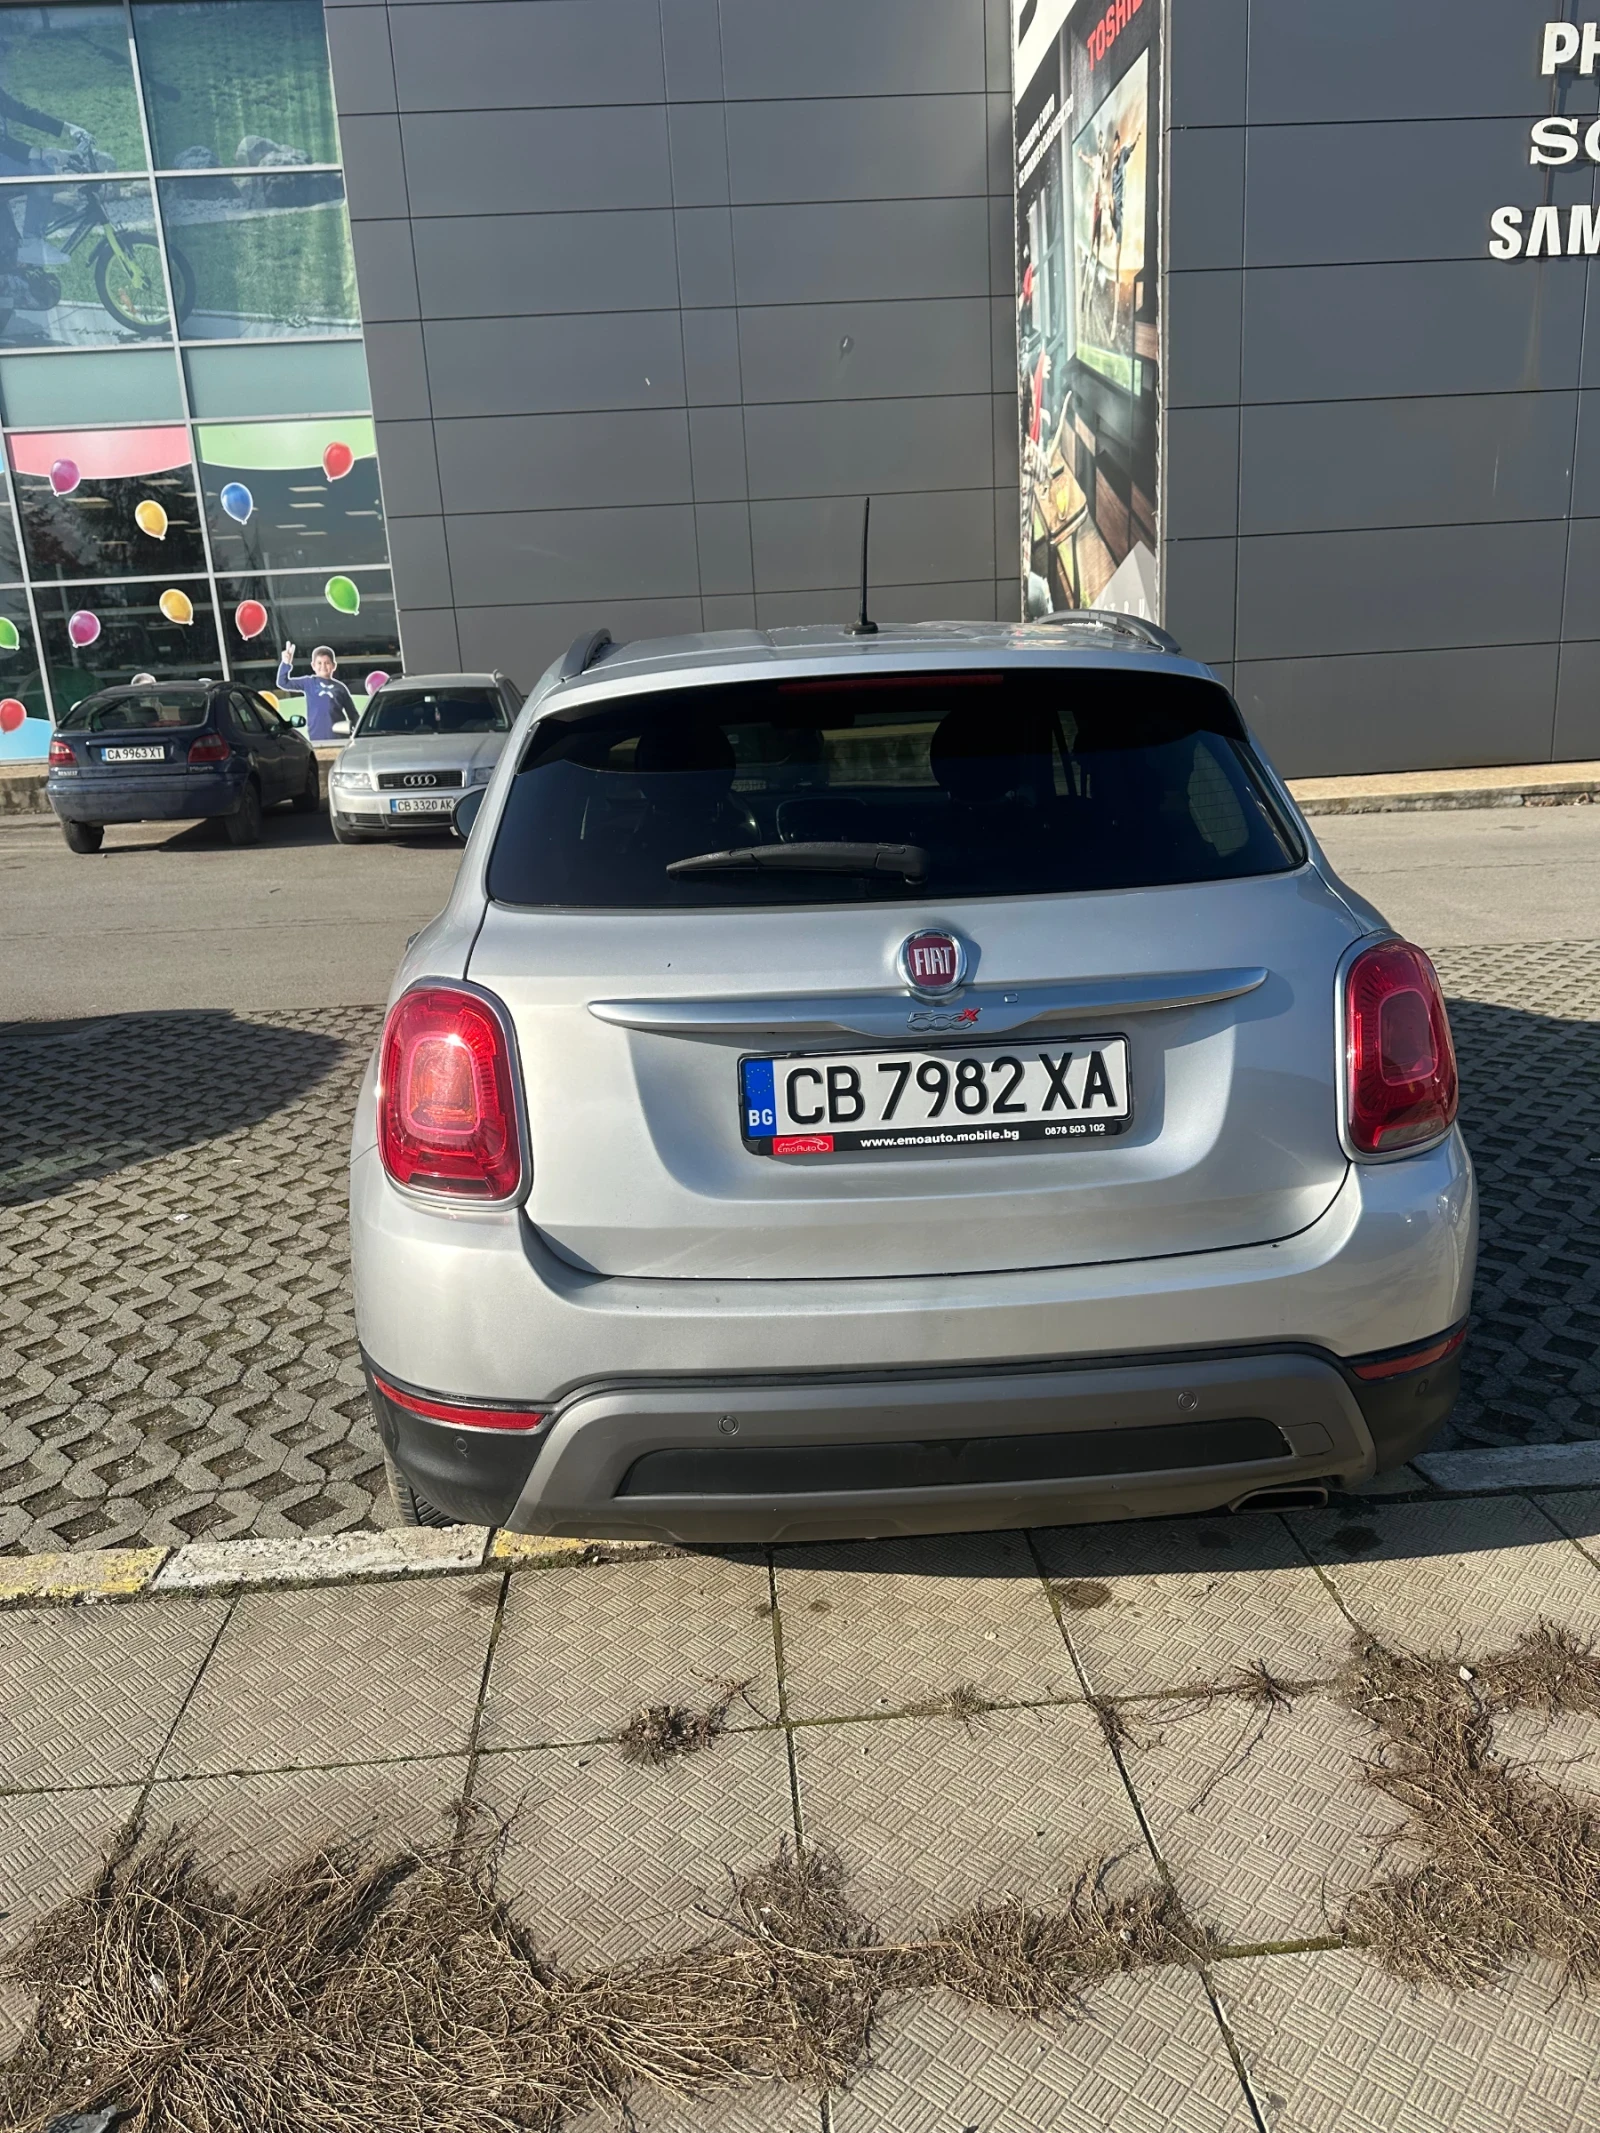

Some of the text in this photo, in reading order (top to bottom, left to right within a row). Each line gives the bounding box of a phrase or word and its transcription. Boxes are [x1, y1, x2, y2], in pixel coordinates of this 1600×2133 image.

[107, 747, 162, 760] CA 9963 XT
[397, 799, 452, 811] CB 3320 AK
[914, 946, 952, 976] FIAT
[786, 1051, 1117, 1125] CB 7982 XA
[748, 1108, 773, 1126] BG
[860, 1129, 1019, 1147] www.emoauto.mobile.bg
[1045, 1123, 1105, 1136] 0878 503 102
